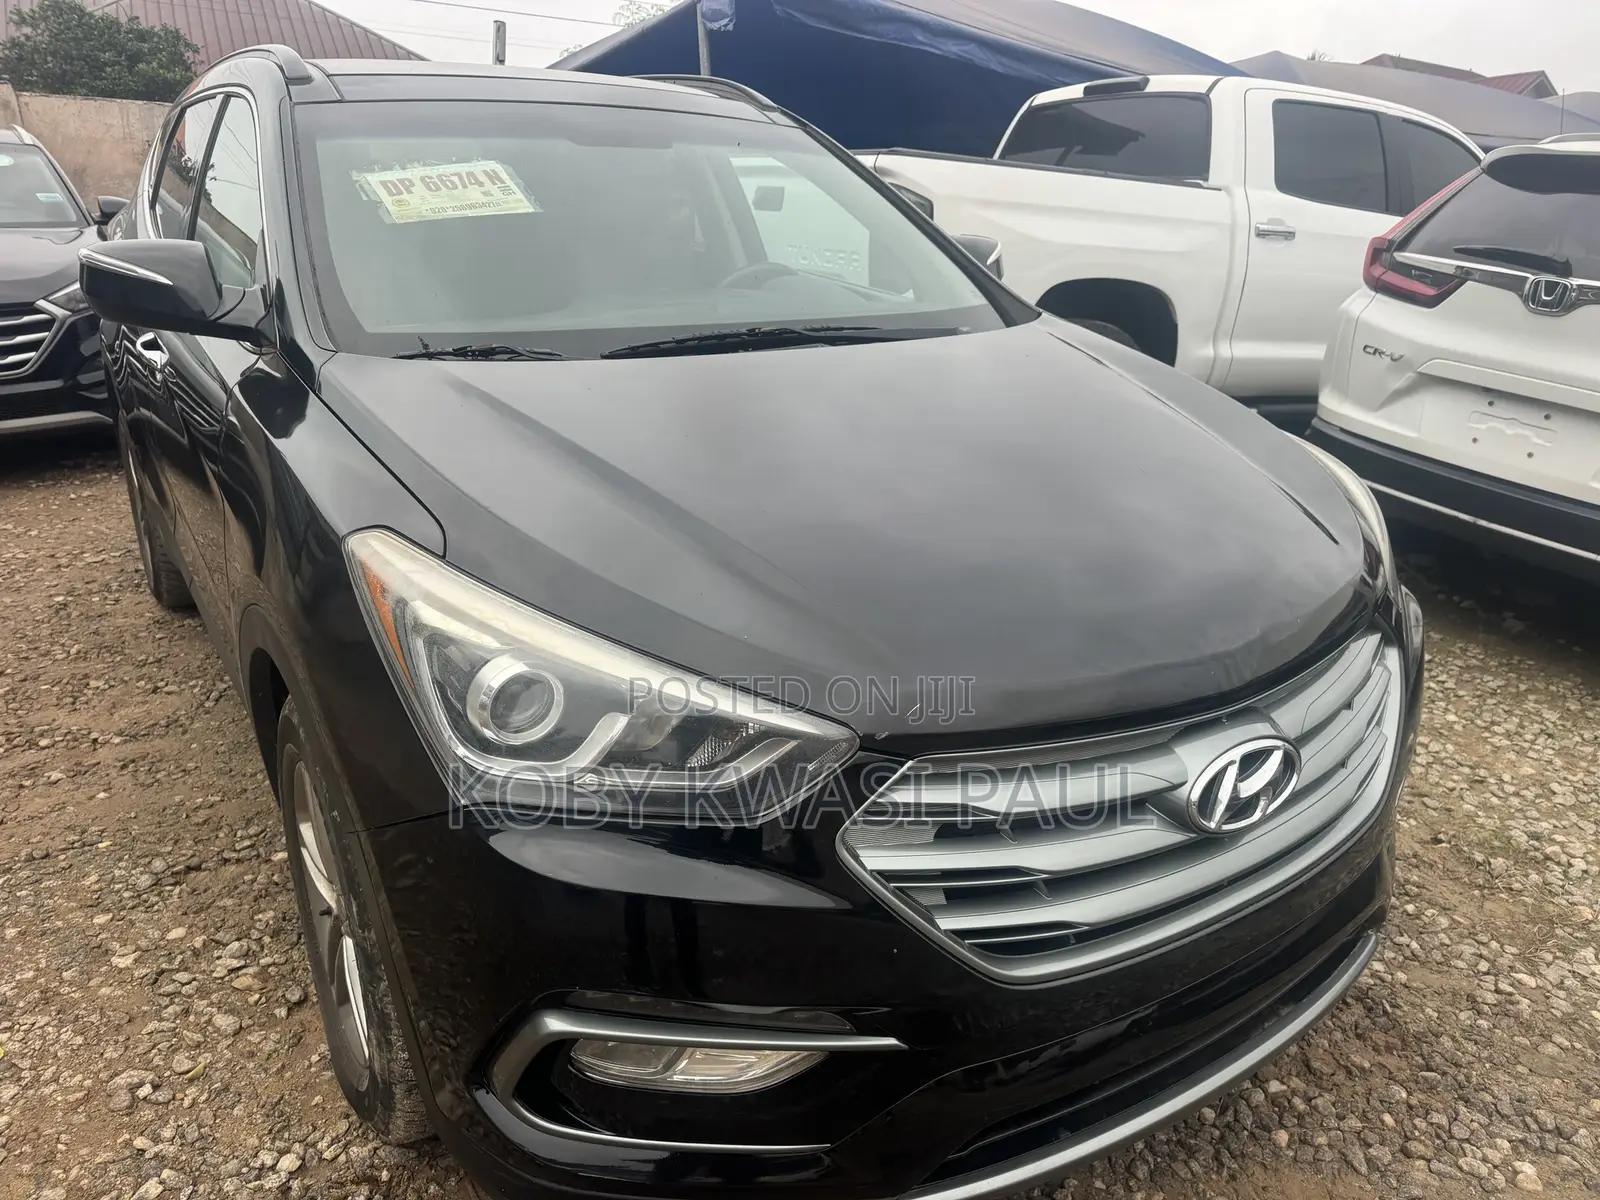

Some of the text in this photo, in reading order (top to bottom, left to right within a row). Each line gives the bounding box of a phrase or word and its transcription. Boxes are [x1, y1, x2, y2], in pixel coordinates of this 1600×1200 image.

[378, 168, 508, 197] DP 6674 N
[1362, 344, 1405, 362] CR-V
